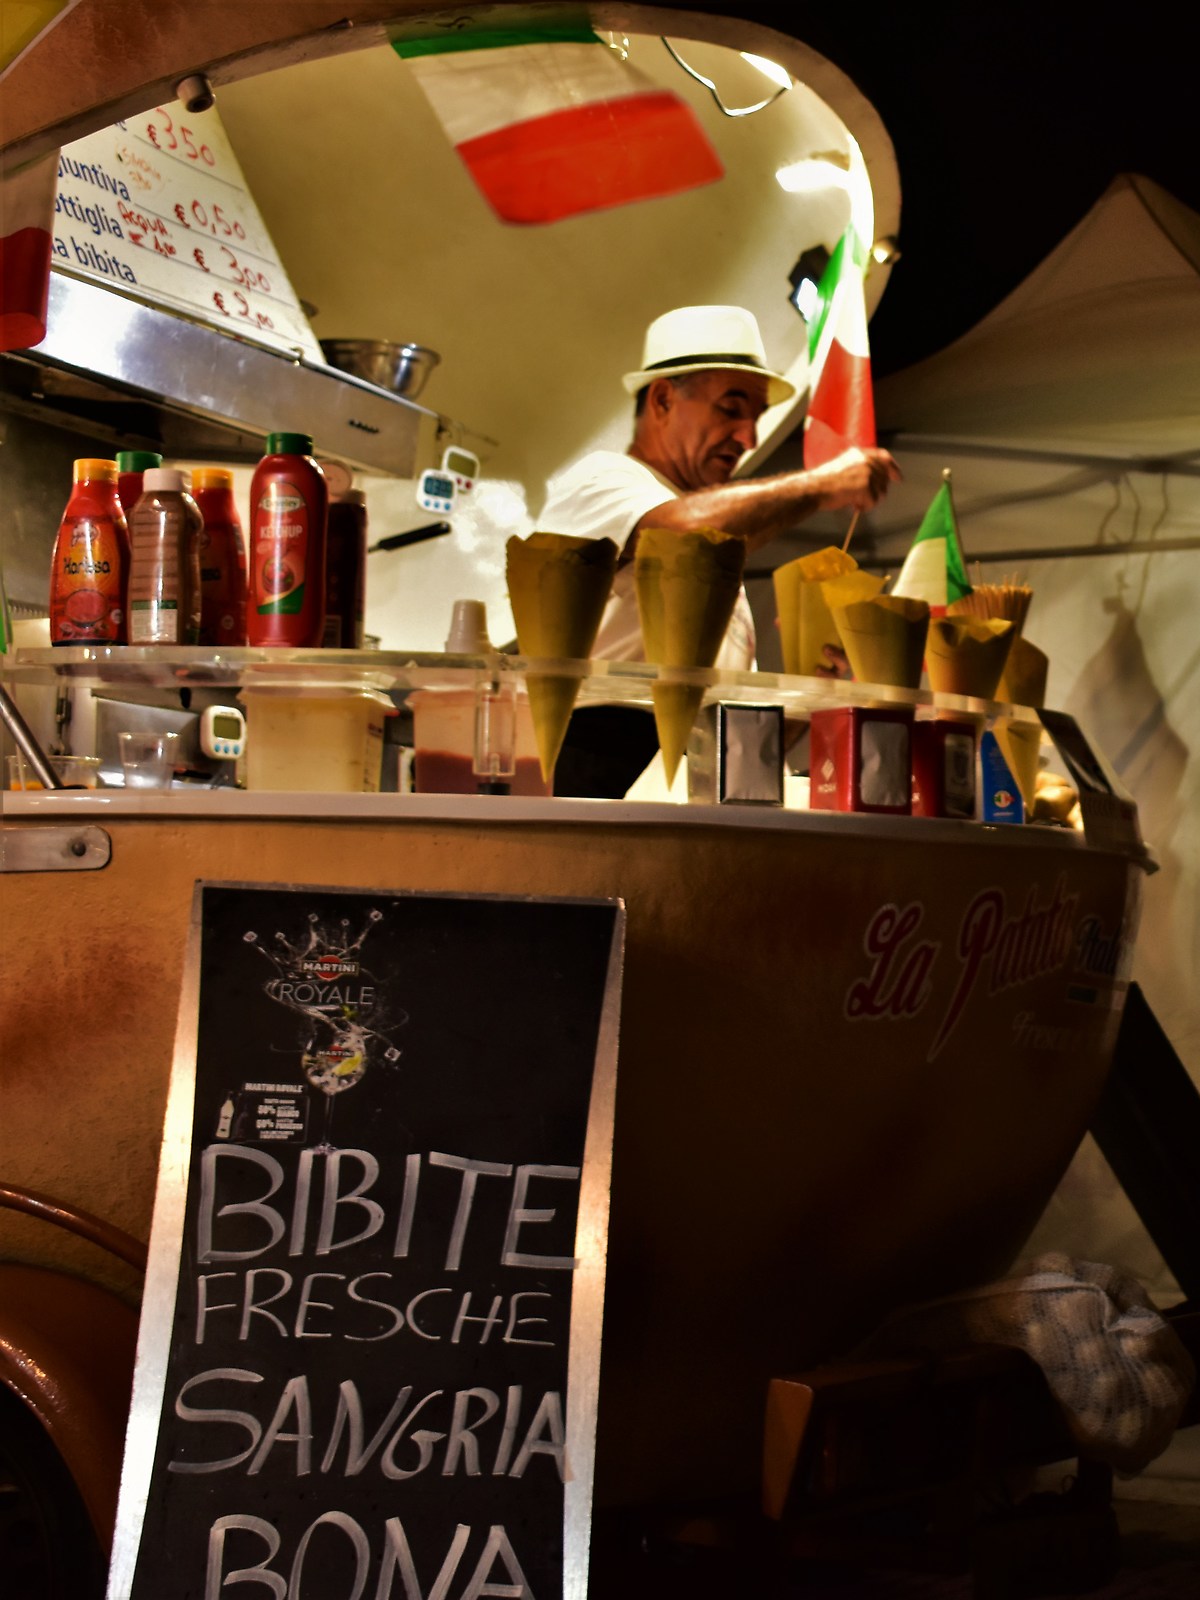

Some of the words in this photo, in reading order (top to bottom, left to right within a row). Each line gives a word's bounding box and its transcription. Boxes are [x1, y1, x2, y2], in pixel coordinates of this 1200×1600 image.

[70, 235, 138, 284] bibita
[278, 983, 375, 1006] ROYALE
[303, 961, 357, 974] MARTINI
[844, 901, 942, 1022] La
[318, 1049, 355, 1058] MARTINI
[196, 1143, 581, 1271] BIBITE
[195, 1267, 556, 1346] FRESCHE
[167, 1367, 575, 1484] SANGRIA
[204, 1511, 538, 1600] BONA
